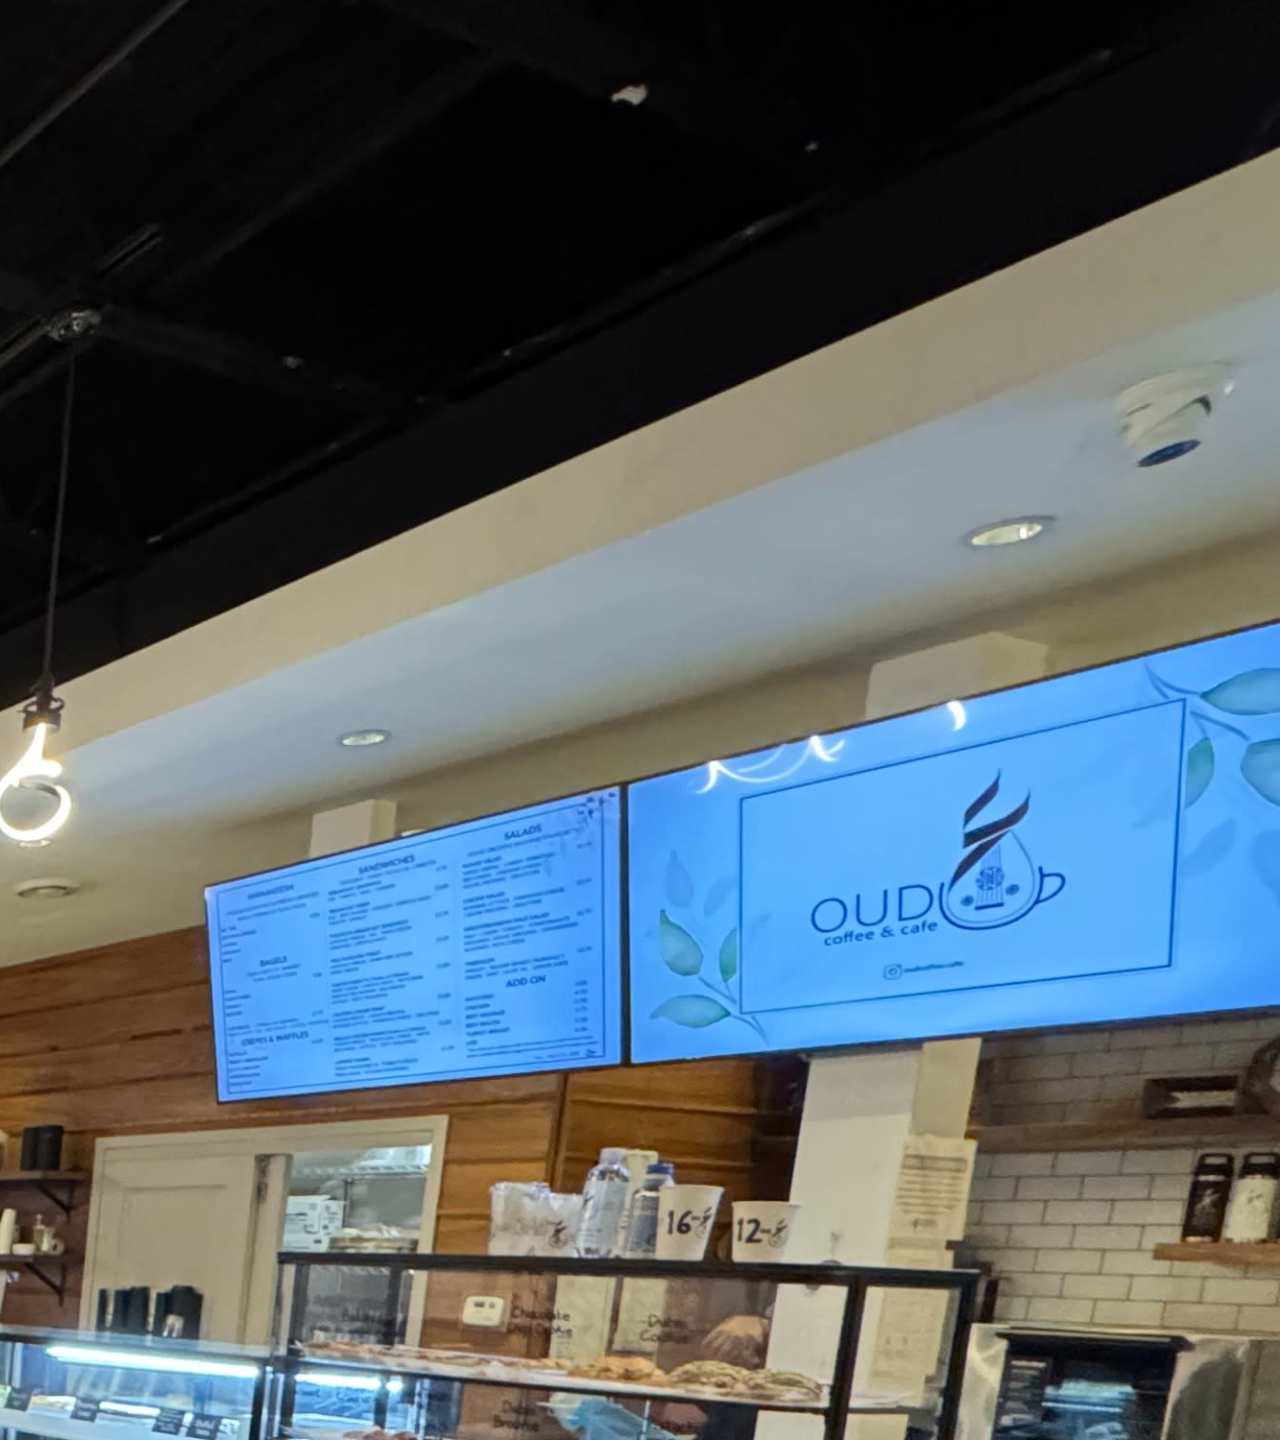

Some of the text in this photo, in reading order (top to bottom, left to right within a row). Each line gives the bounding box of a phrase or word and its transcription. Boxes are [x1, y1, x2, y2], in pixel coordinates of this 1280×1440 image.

[811, 884, 934, 933] OUD
[824, 919, 939, 946] coffee & cafe
[505, 974, 547, 988] ADD ON
